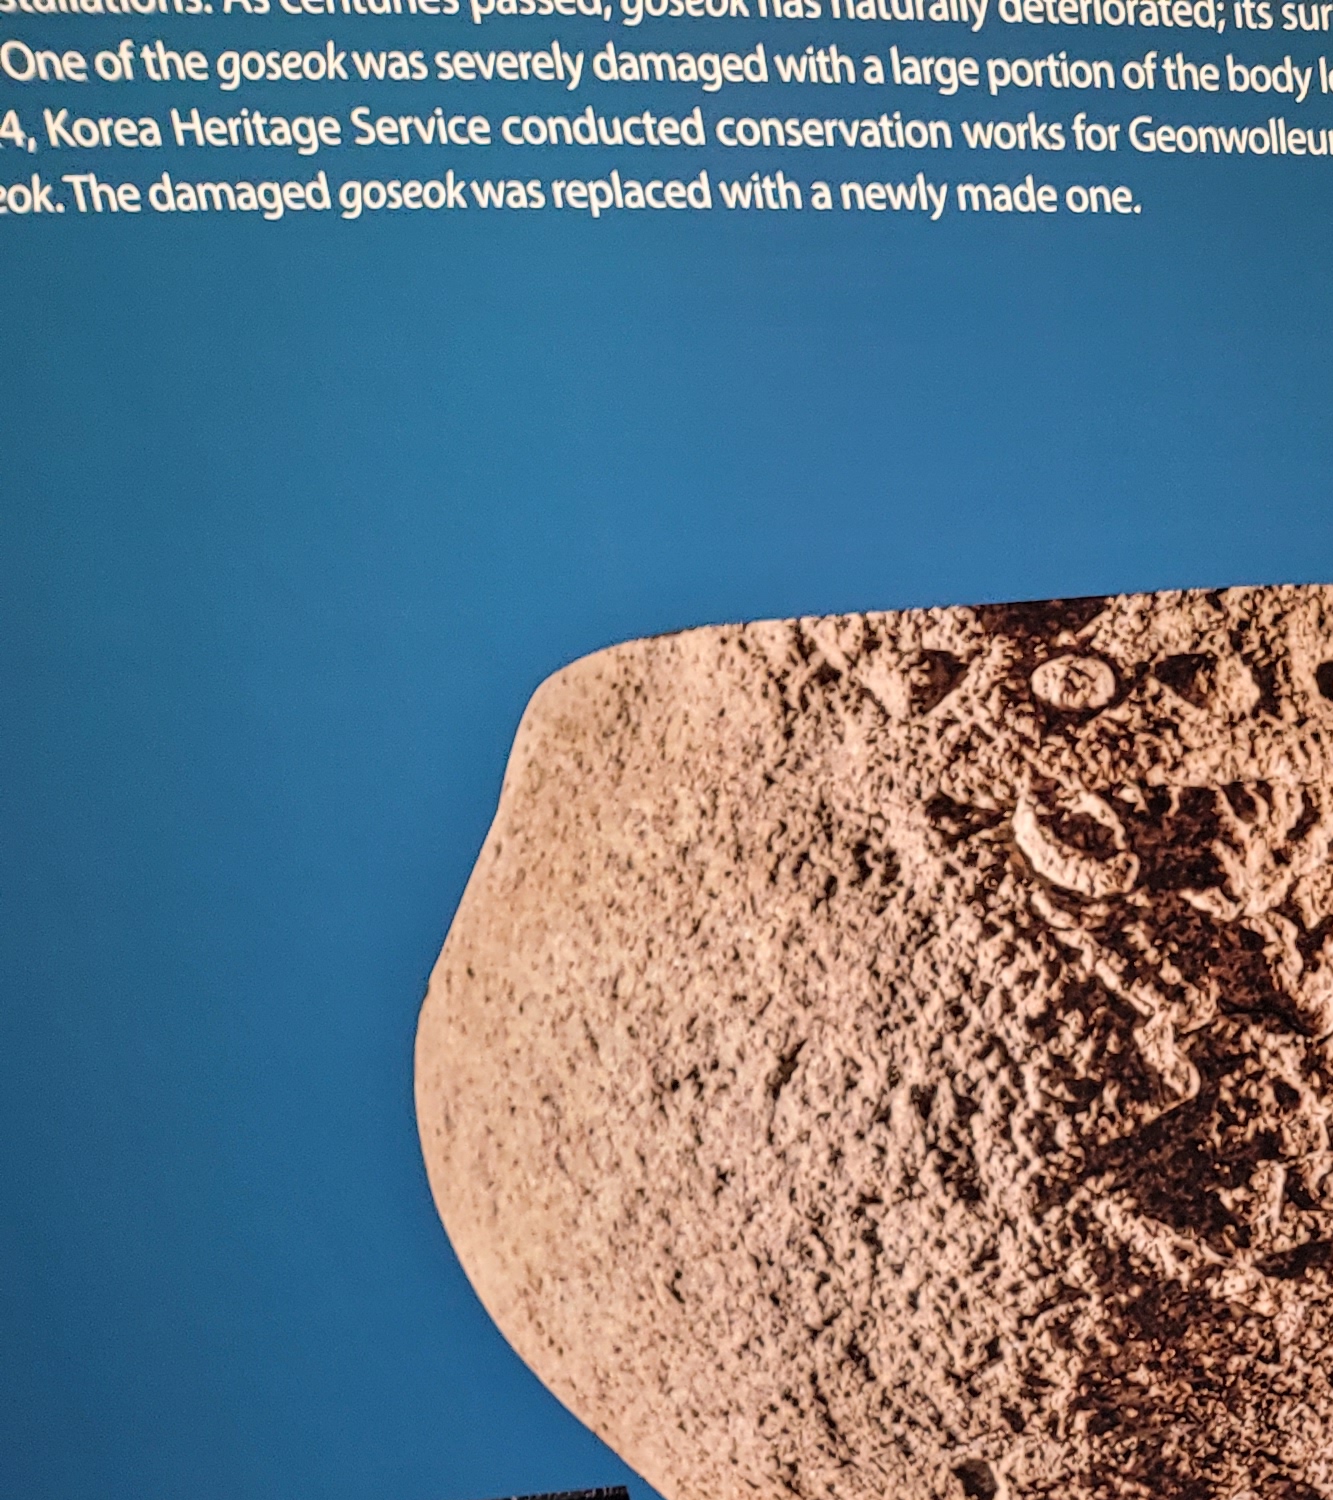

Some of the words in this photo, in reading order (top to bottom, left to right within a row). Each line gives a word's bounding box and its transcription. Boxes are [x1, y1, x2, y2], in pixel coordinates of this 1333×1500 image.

[1233, 0, 1273, 30] its
[2, 39, 89, 82] One
[94, 38, 135, 81] of
[139, 39, 209, 81] the
[216, 39, 348, 91] goseok
[352, 50, 428, 81] was
[434, 40, 585, 91] severely
[592, 40, 768, 92] damaged
[774, 44, 856, 84] with
[862, 55, 884, 84] a
[890, 46, 980, 95] large
[986, 51, 1116, 96] portion
[1121, 51, 1157, 90] of
[1162, 52, 1220, 92] the
[1226, 53, 1313, 103] body
[43, 107, 163, 148] Korea
[170, 107, 341, 155] Heritage
[349, 106, 491, 145] Service
[502, 105, 706, 146] conducted
[715, 112, 953, 150] conservation
[961, 111, 1065, 151] works
[1071, 111, 1120, 152] for
[62, 174, 141, 213] The
[148, 170, 331, 221] damaged
[340, 169, 468, 220] goseok
[470, 178, 546, 209] was
[551, 169, 712, 219] replaced
[718, 170, 803, 210] with
[810, 181, 832, 211] a
[840, 172, 947, 221] newly
[957, 174, 1058, 212] made
[1066, 184, 1142, 215] one.
